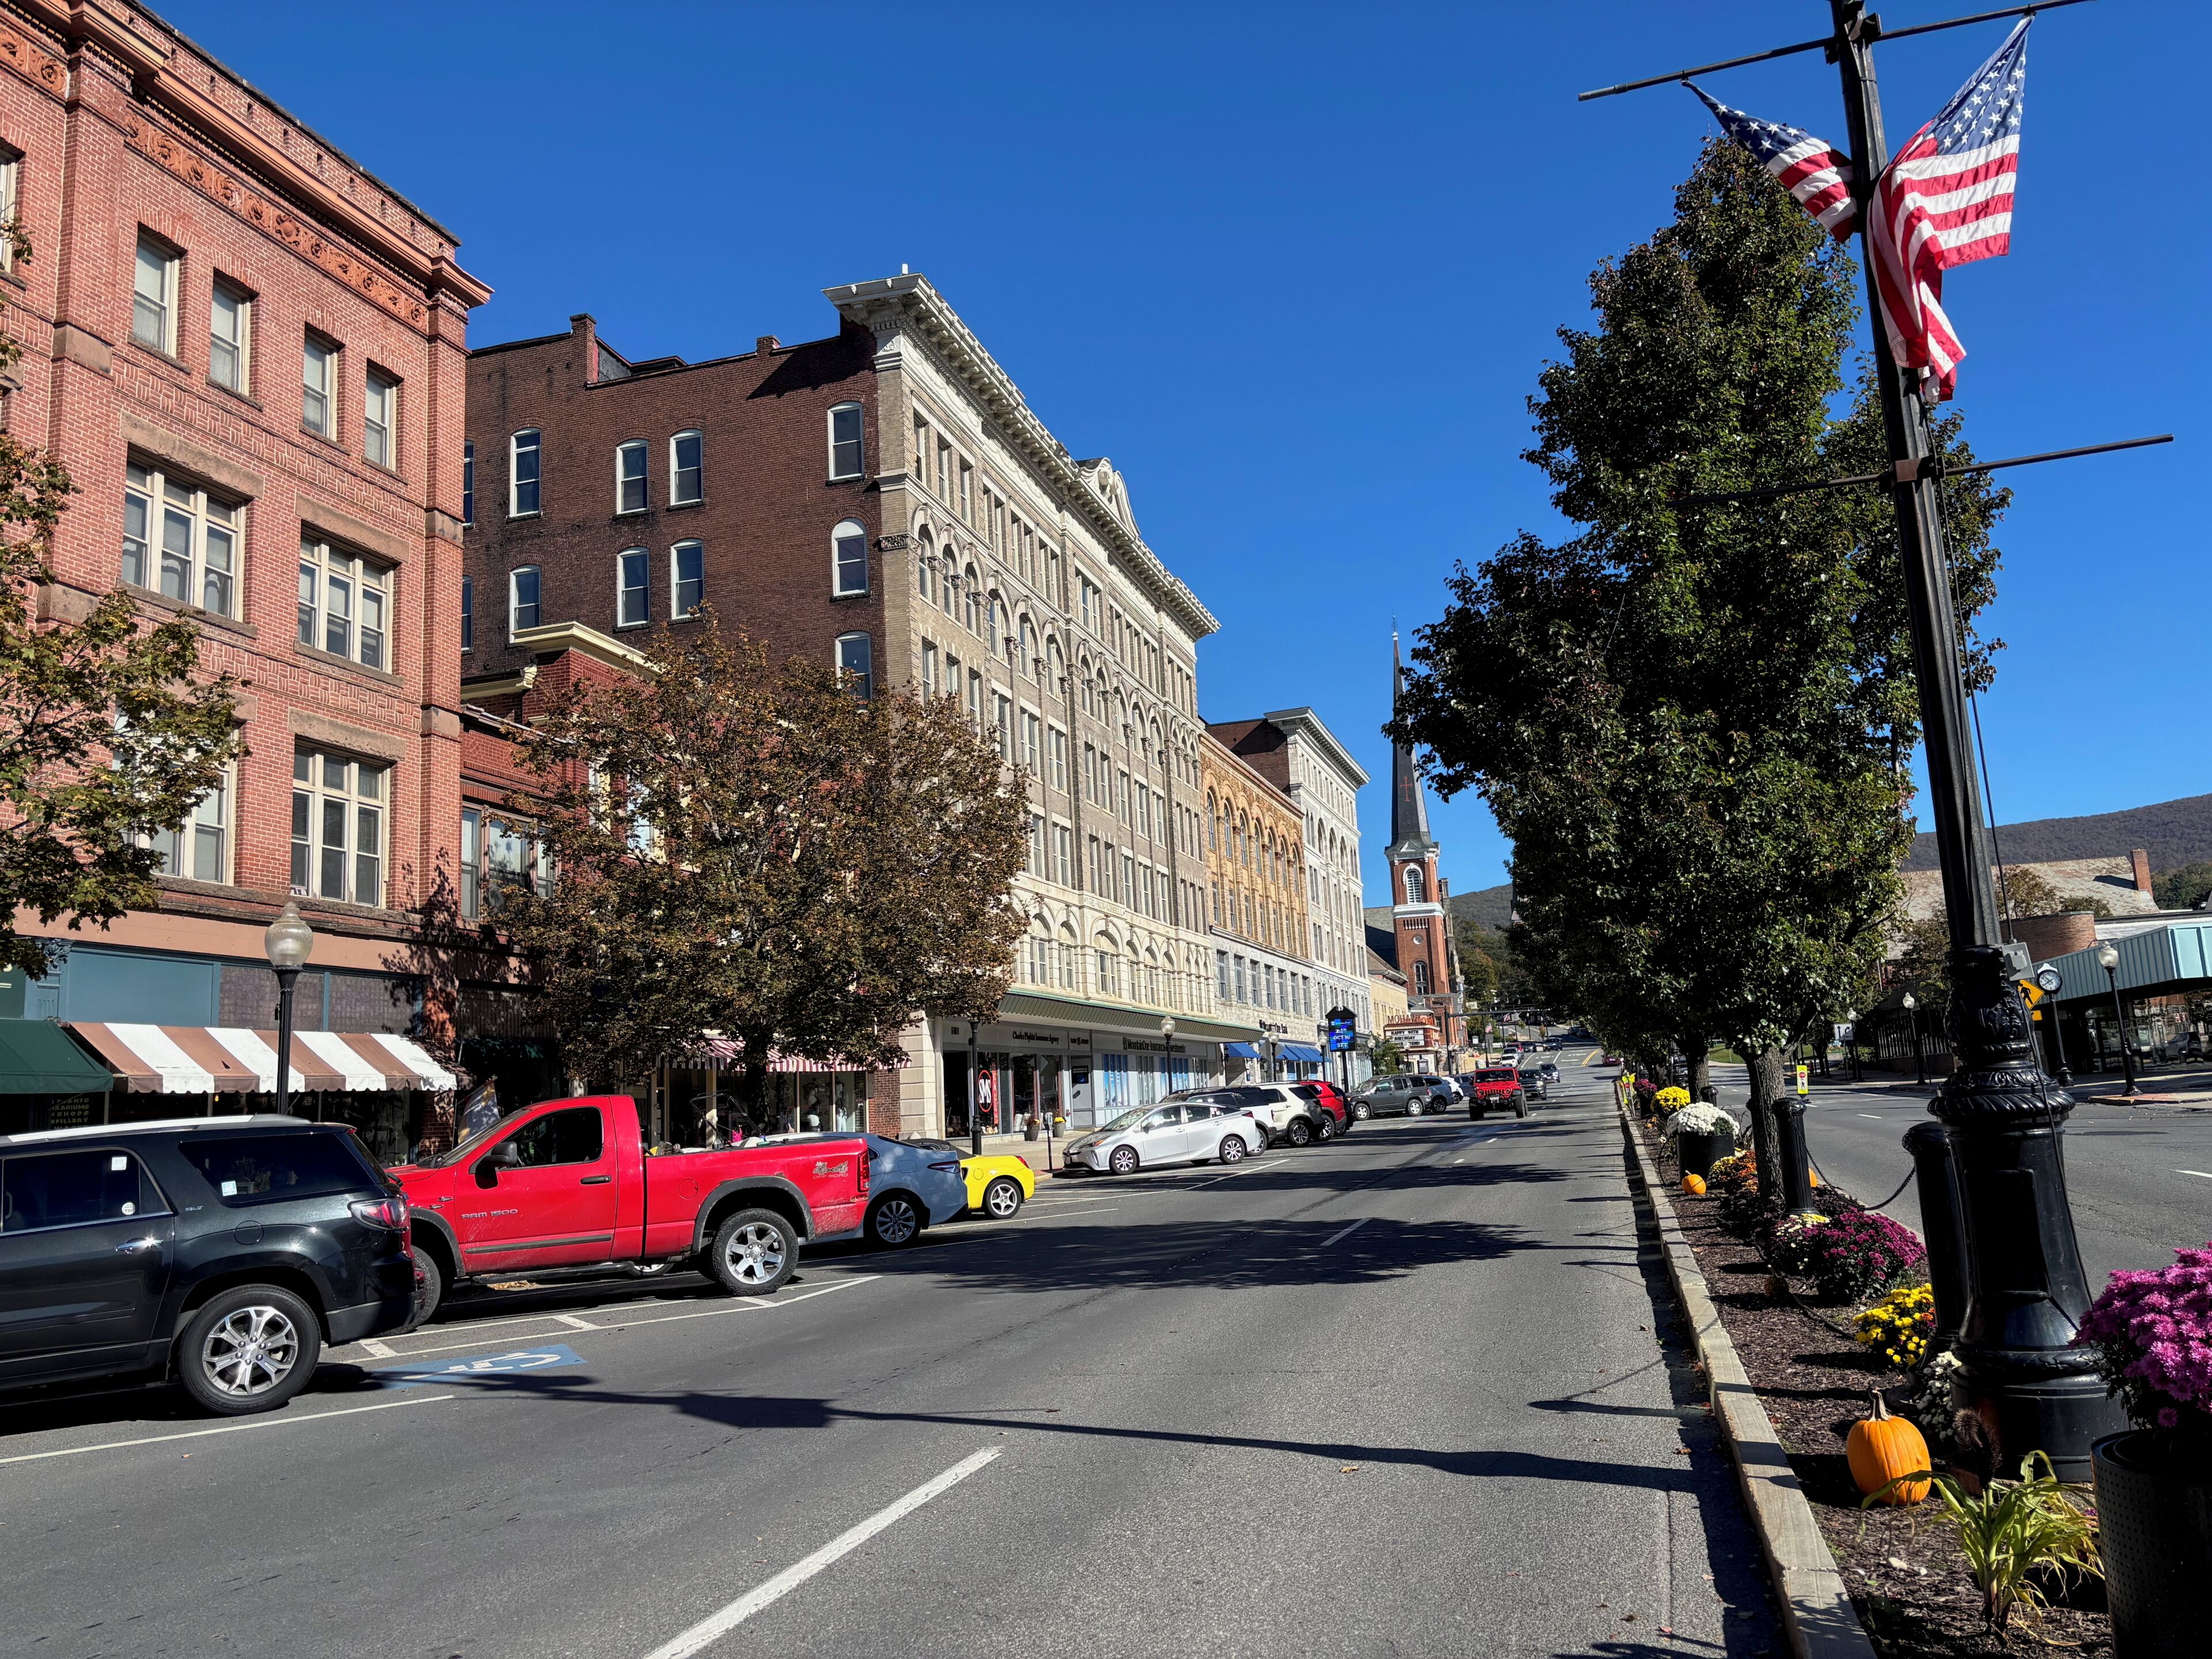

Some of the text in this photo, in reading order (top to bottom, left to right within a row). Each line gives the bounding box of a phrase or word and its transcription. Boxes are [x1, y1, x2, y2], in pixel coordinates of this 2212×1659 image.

[951, 1027, 960, 1035] SMS
[979, 1078, 991, 1104] SMS
[461, 1209, 518, 1220] RAM 1500
